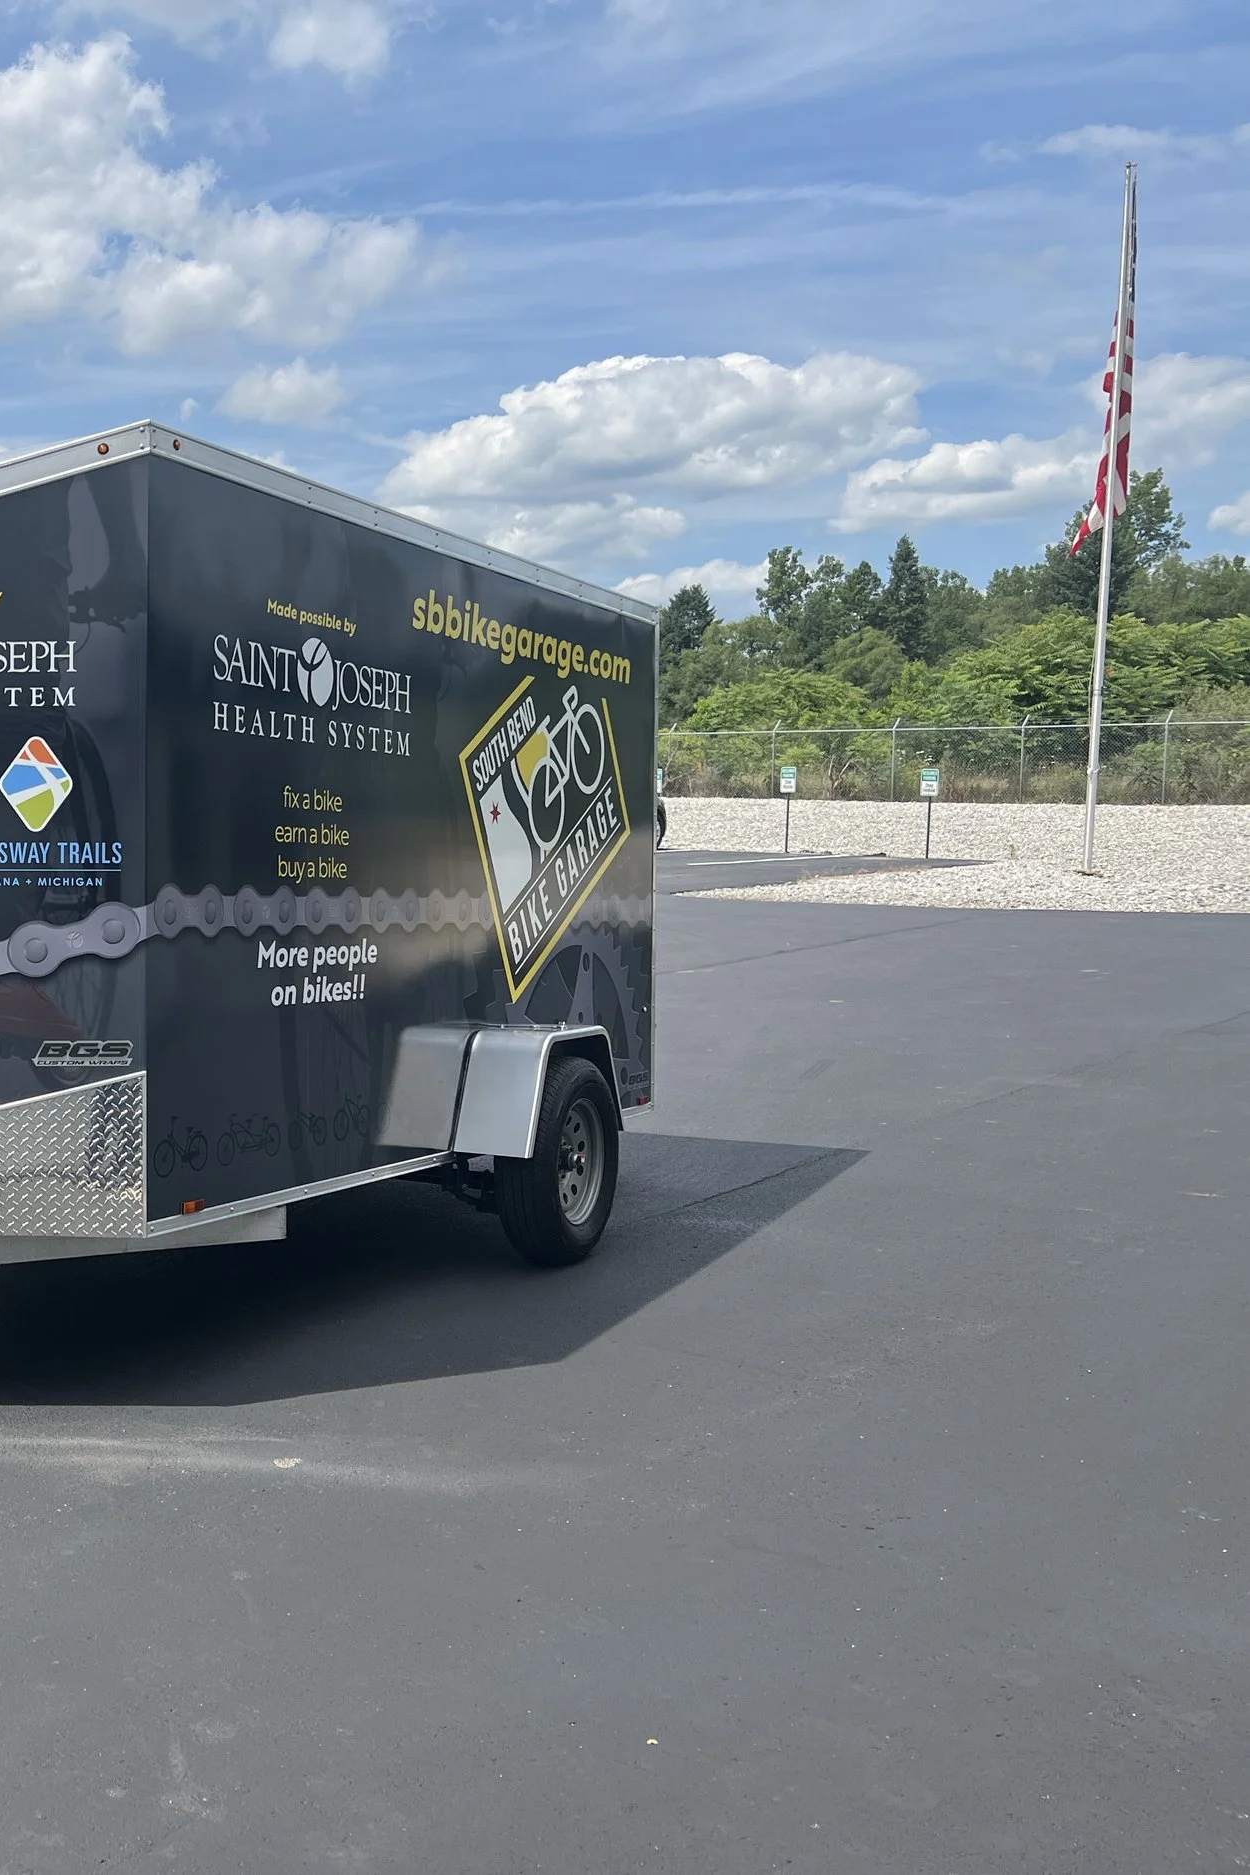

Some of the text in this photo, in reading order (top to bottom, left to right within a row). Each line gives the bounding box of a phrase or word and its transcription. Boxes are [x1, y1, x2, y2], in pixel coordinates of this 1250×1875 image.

[267, 598, 357, 637] Made possible by
[412, 589, 631, 684] sbbikegarage.com
[213, 634, 412, 714] SAINT JOSEPH
[213, 701, 411, 757] HEALTH SYSTEM
[472, 695, 537, 792] SOUTH BEND
[283, 785, 343, 812] fix a bike
[275, 823, 349, 846] earn a bike
[57, 842, 122, 864] TRAILS
[278, 855, 347, 884] buy a bike
[37, 877, 103, 887] MICHIGAN
[507, 787, 618, 965] BIKE GARAGE
[257, 938, 378, 973] More people
[271, 974, 365, 1006] on bikes!!
[37, 1042, 130, 1057] BGS
